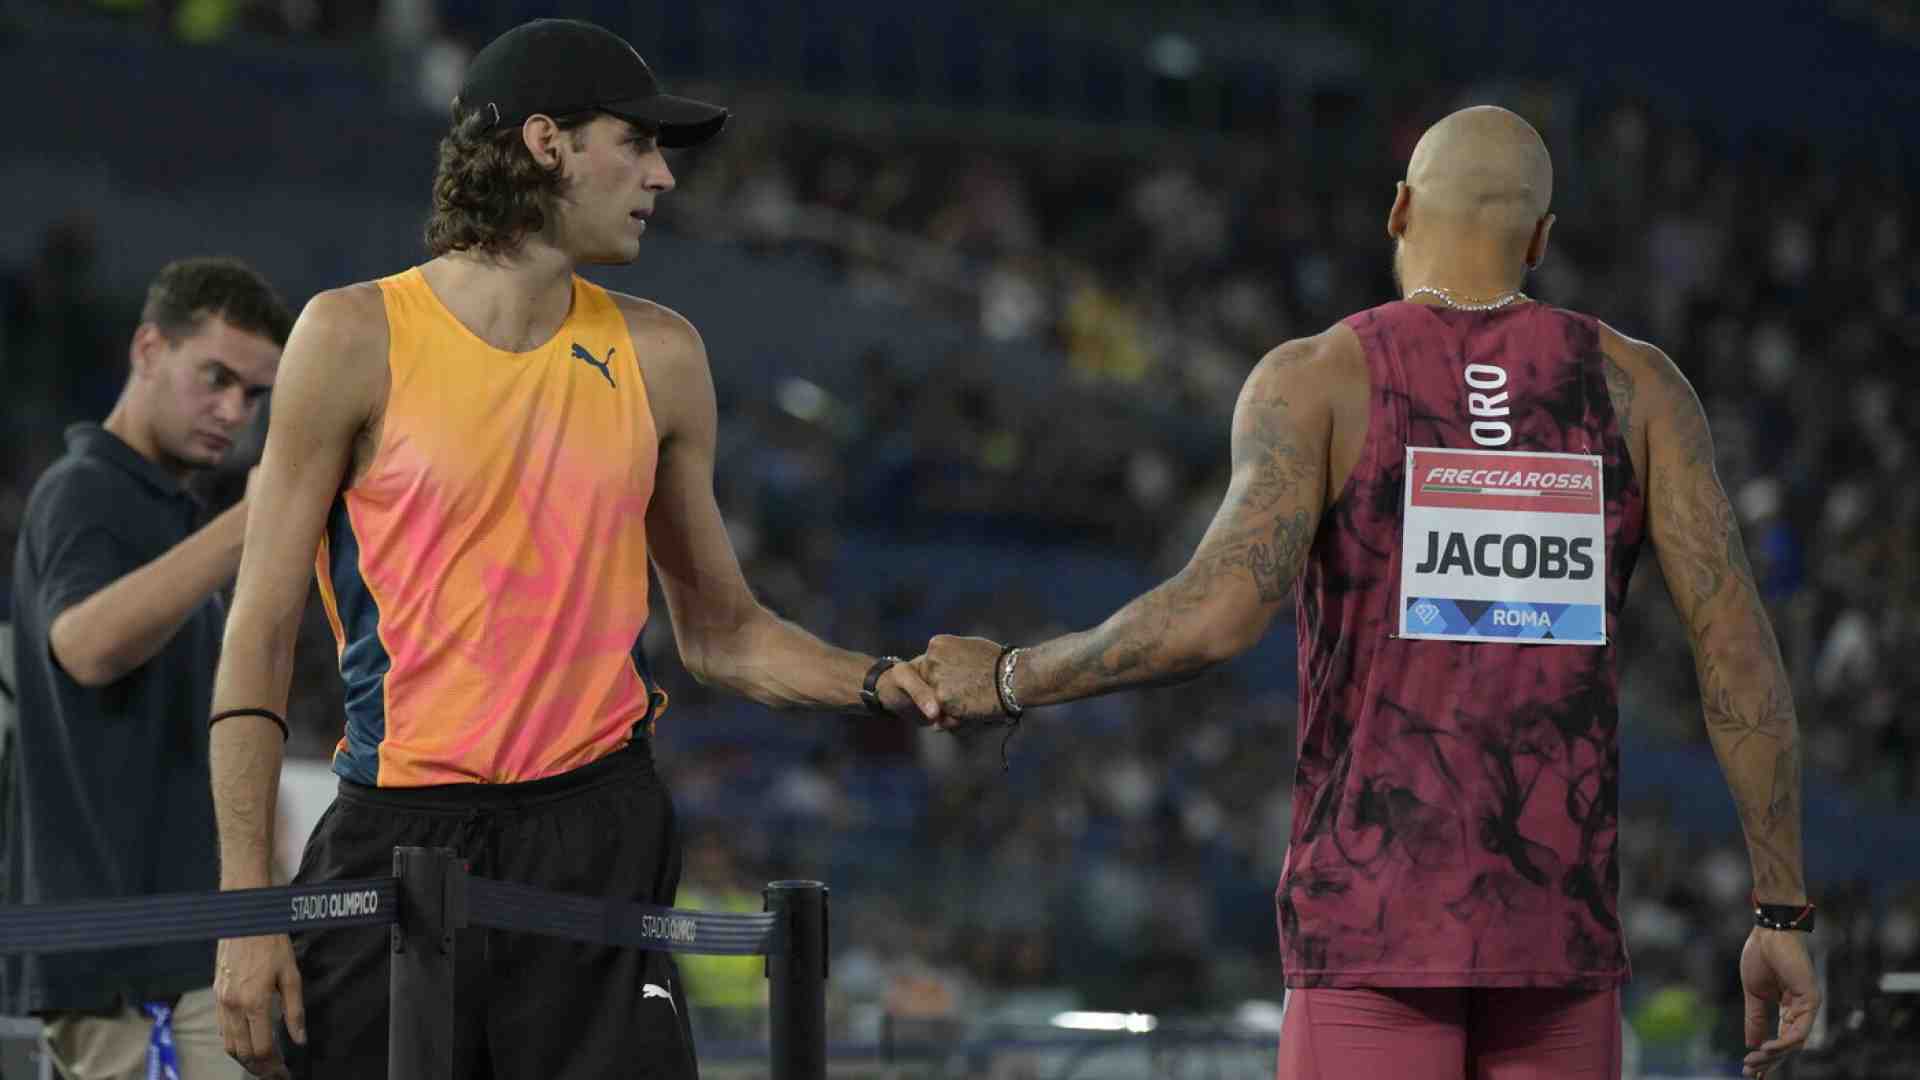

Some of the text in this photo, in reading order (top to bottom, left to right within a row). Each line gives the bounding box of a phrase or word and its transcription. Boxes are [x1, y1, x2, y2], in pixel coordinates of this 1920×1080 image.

[1464, 363, 1512, 446] ORO
[1426, 467, 1593, 490] FRECCIAROSSA
[1415, 531, 1594, 580] JACOBS
[1493, 609, 1551, 626] ROMA
[291, 890, 378, 921] STADIO OLIMPICO
